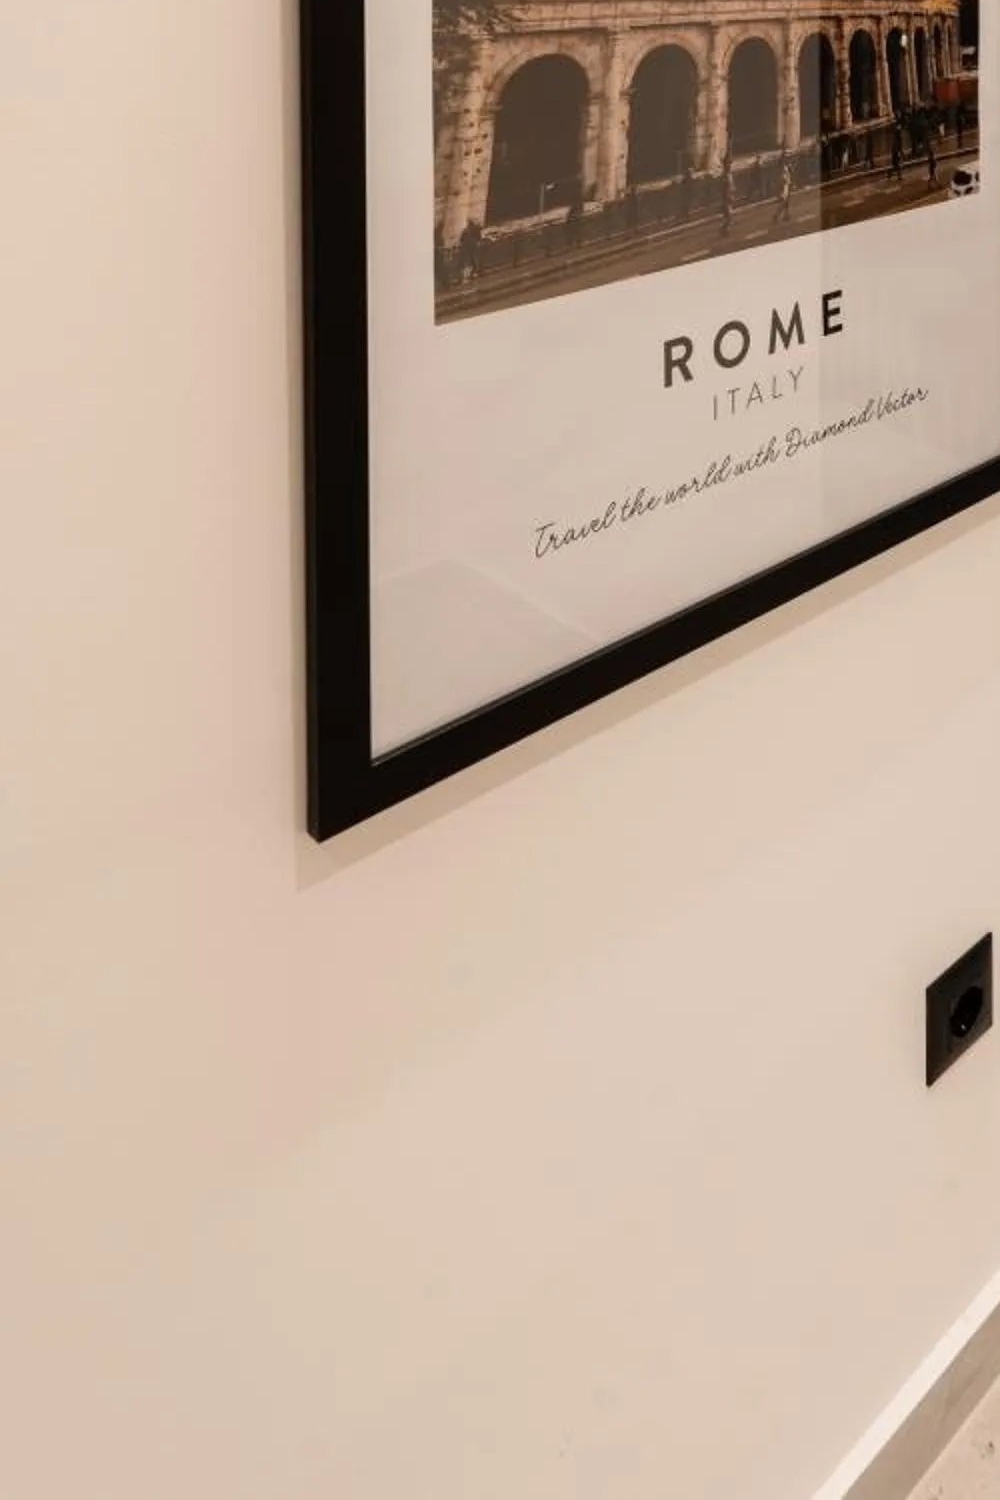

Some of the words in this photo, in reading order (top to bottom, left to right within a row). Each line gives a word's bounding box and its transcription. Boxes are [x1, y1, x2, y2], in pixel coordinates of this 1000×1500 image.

[663, 289, 844, 389] ROME
[712, 366, 805, 421] ITALY
[535, 501, 616, 558] Travel
[620, 487, 661, 522] the
[664, 455, 731, 505] world
[733, 436, 780, 476] with
[785, 398, 875, 458] Diamond
[876, 387, 930, 421] Vector
